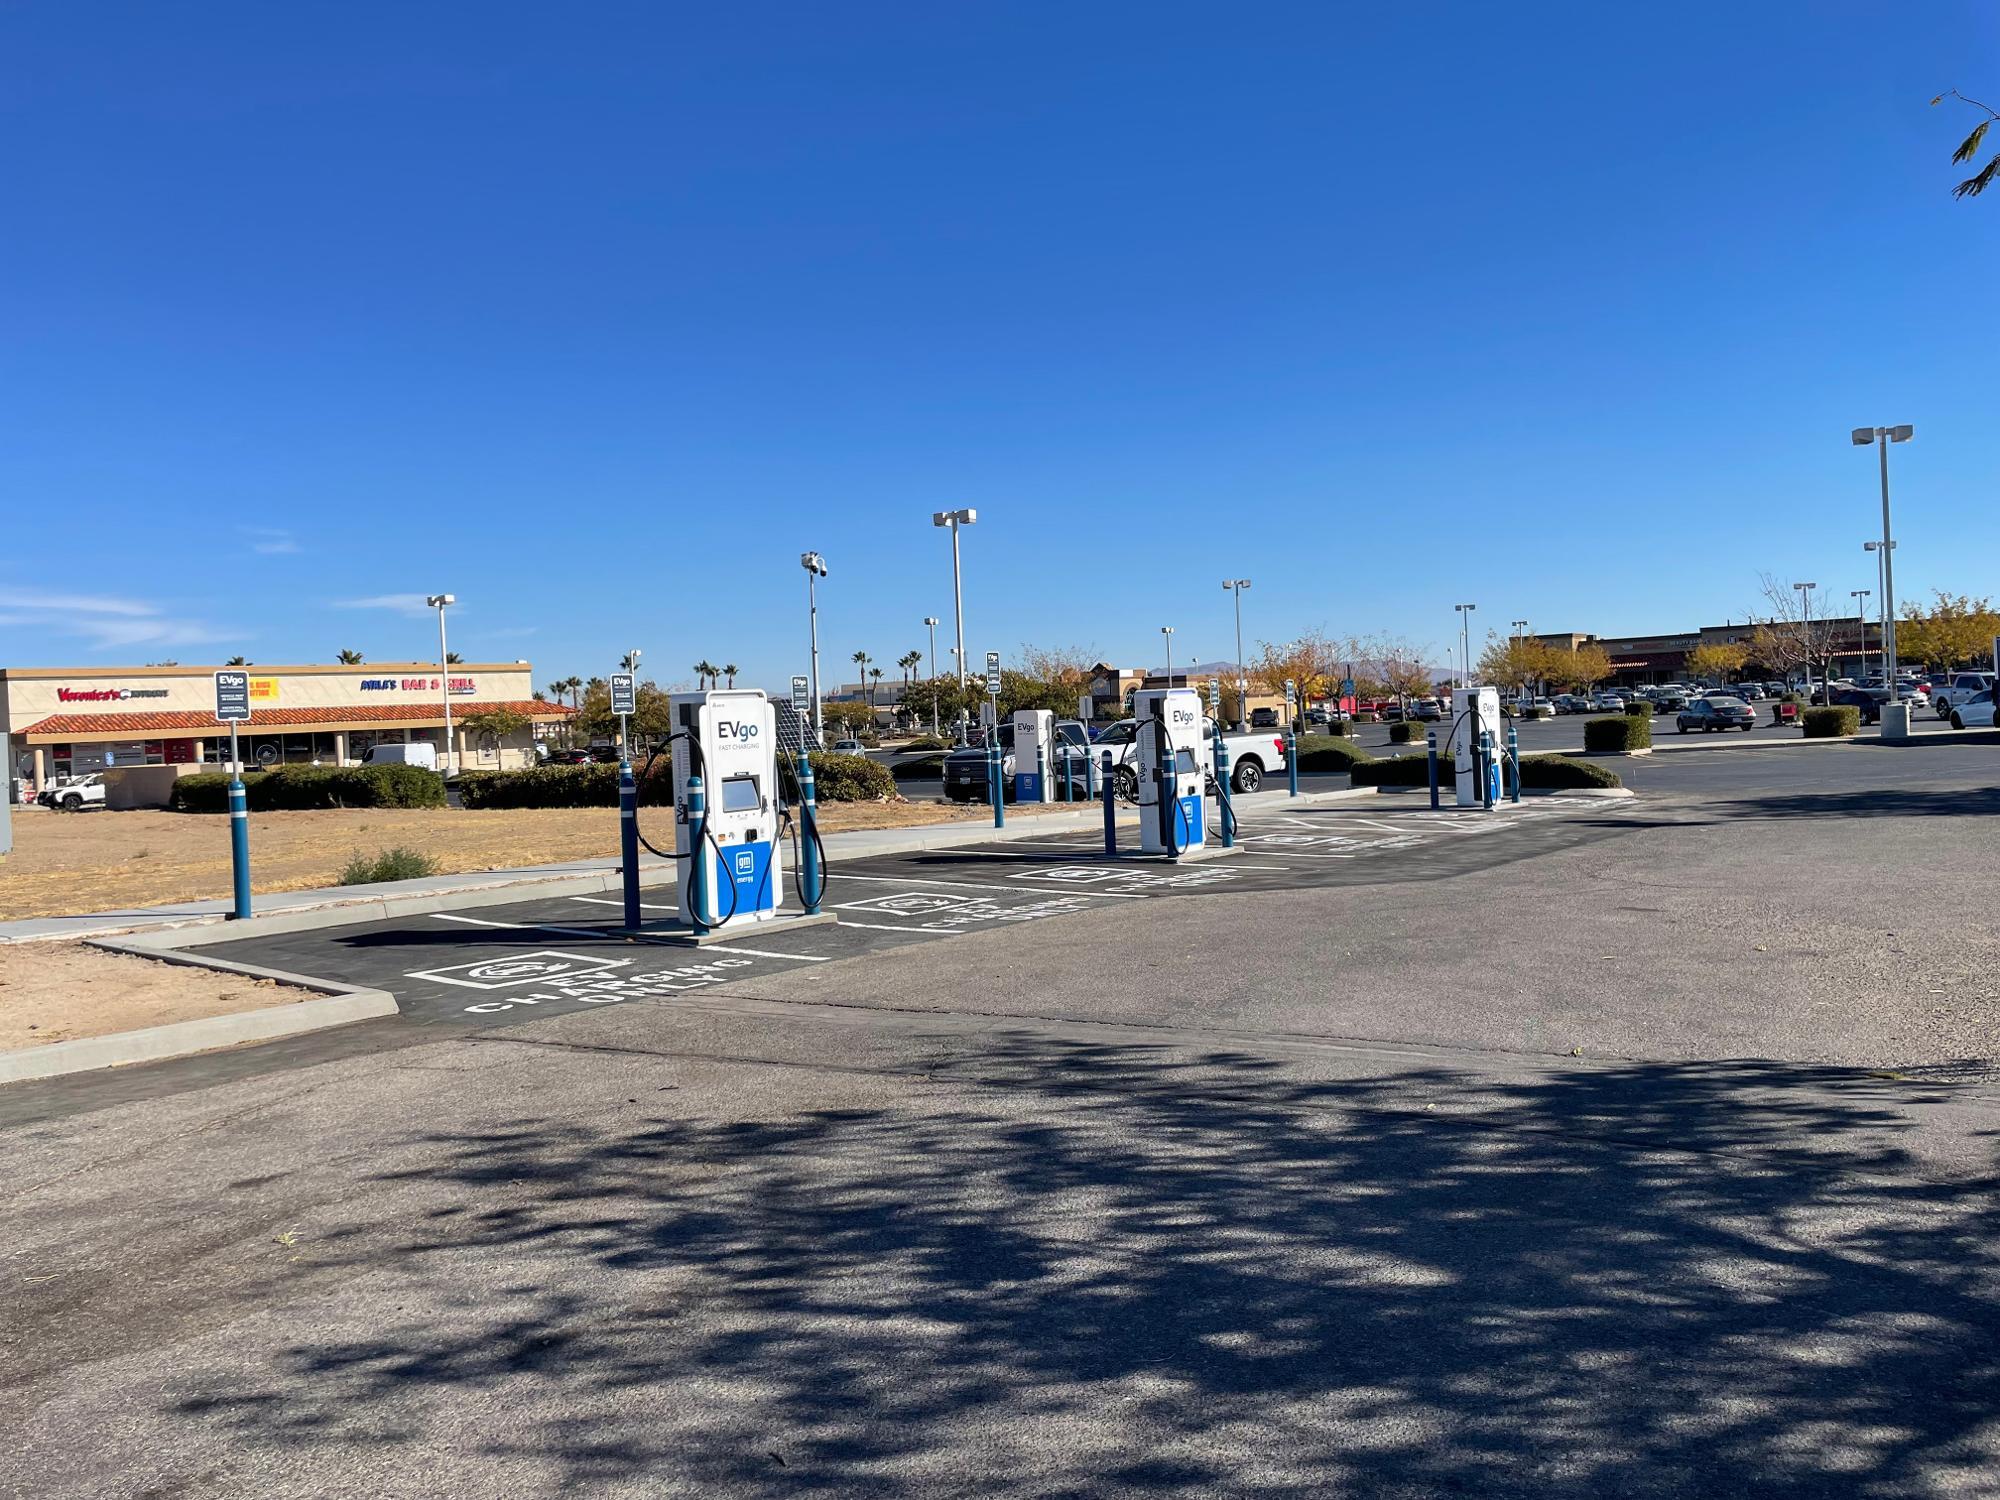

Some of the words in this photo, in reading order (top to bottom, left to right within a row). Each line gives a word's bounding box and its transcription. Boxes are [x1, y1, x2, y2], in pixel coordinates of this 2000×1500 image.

[219, 675, 244, 686] EVgo
[402, 679, 426, 691] BAR
[613, 677, 631, 686] EVgo
[57, 688, 121, 702] Veronica's
[1173, 710, 1195, 725] EVgo
[717, 721, 759, 742] EVgo
[1017, 722, 1035, 732] EVgo
[732, 743, 760, 751] CHARGING
[1139, 763, 1148, 783] EVgo
[464, 959, 753, 1013] CHARGING
[541, 972, 619, 988] EV
[577, 973, 727, 1003] ONLY
